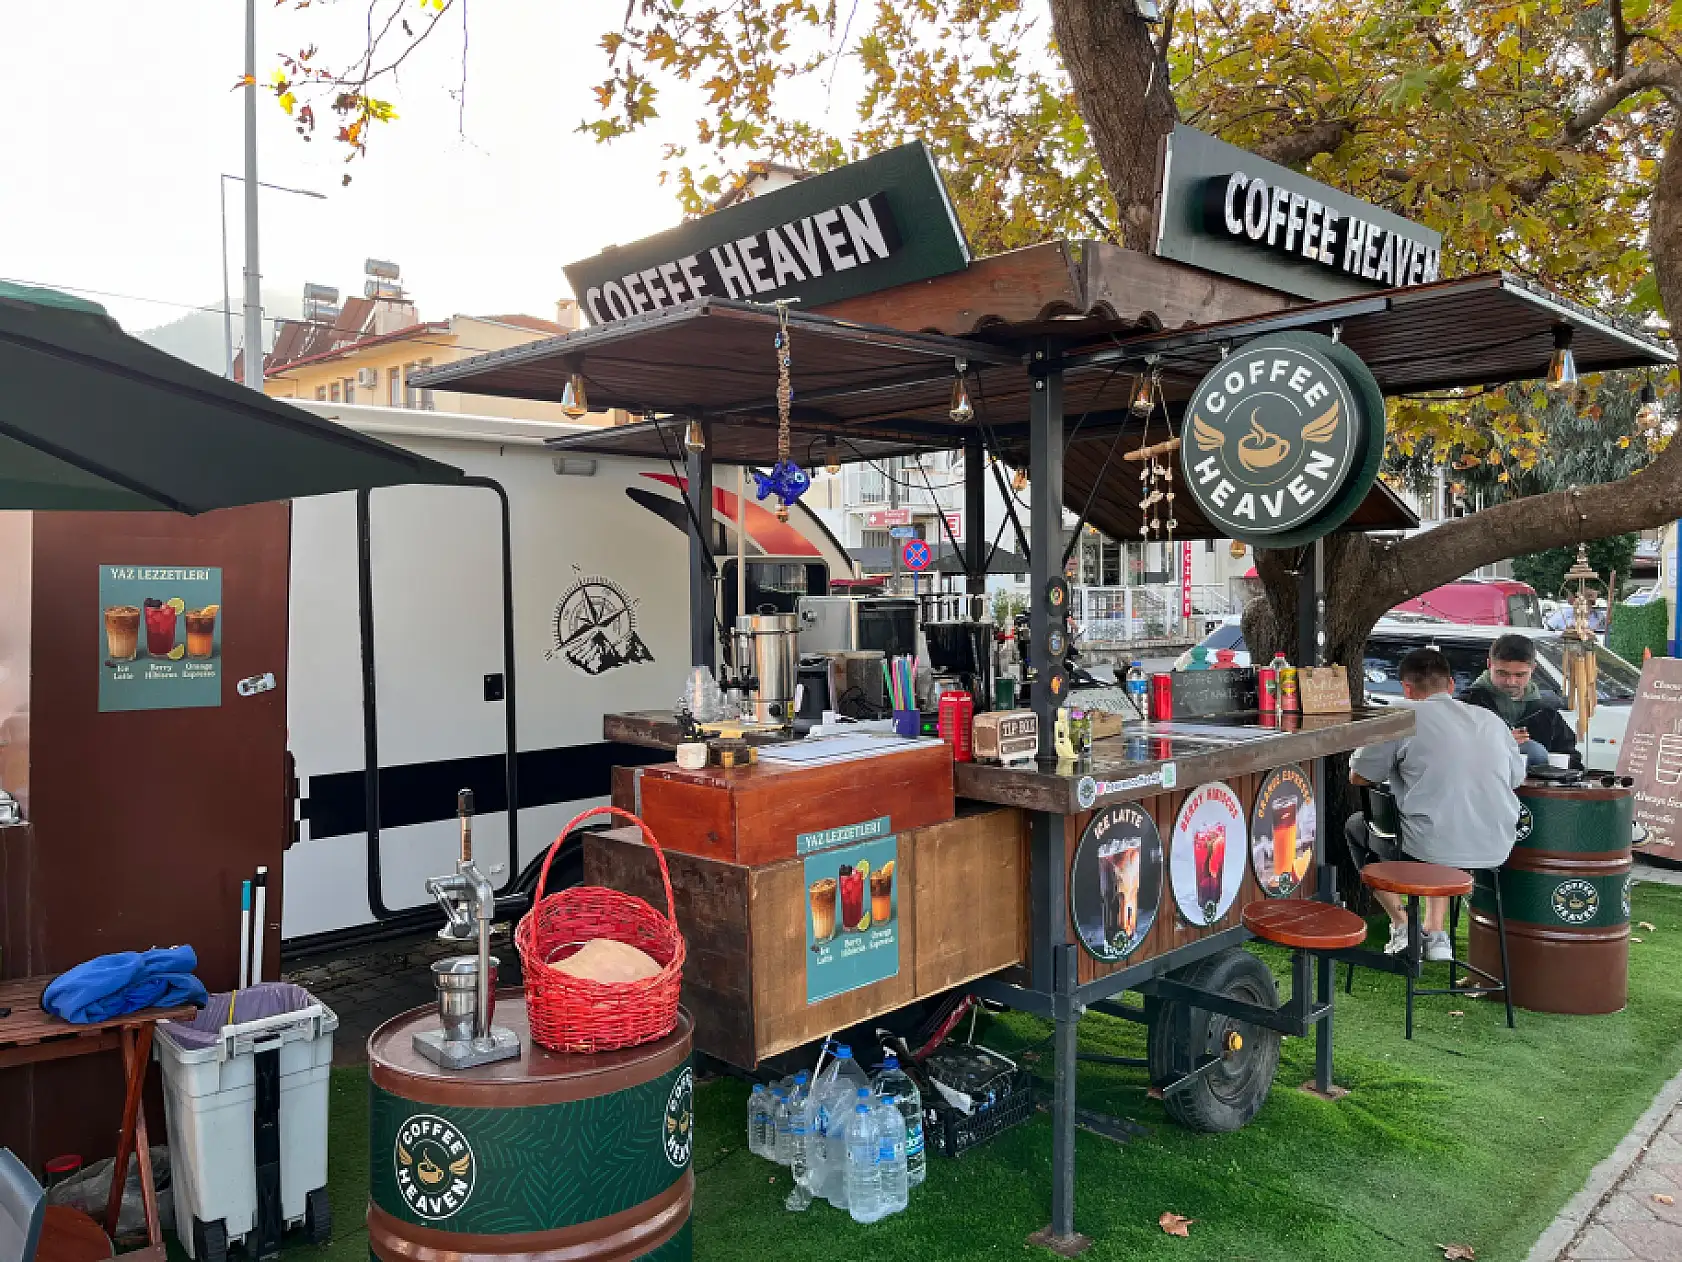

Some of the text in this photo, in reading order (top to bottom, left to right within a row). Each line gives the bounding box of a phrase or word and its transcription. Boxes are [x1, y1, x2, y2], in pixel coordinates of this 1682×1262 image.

[1224, 170, 1439, 288] COFFEE HEAVEN
[586, 197, 890, 325] COFFEE HEAVEN
[1205, 359, 1329, 414] COFFEE
[1194, 450, 1336, 520] HEAVEN
[110, 567, 135, 580] YAZ
[805, 834, 825, 849] YAZ
[1094, 808, 1144, 840] ICE LATTE
[403, 1120, 465, 1155] COFFEE
[398, 1167, 468, 1214] HEAVEN
